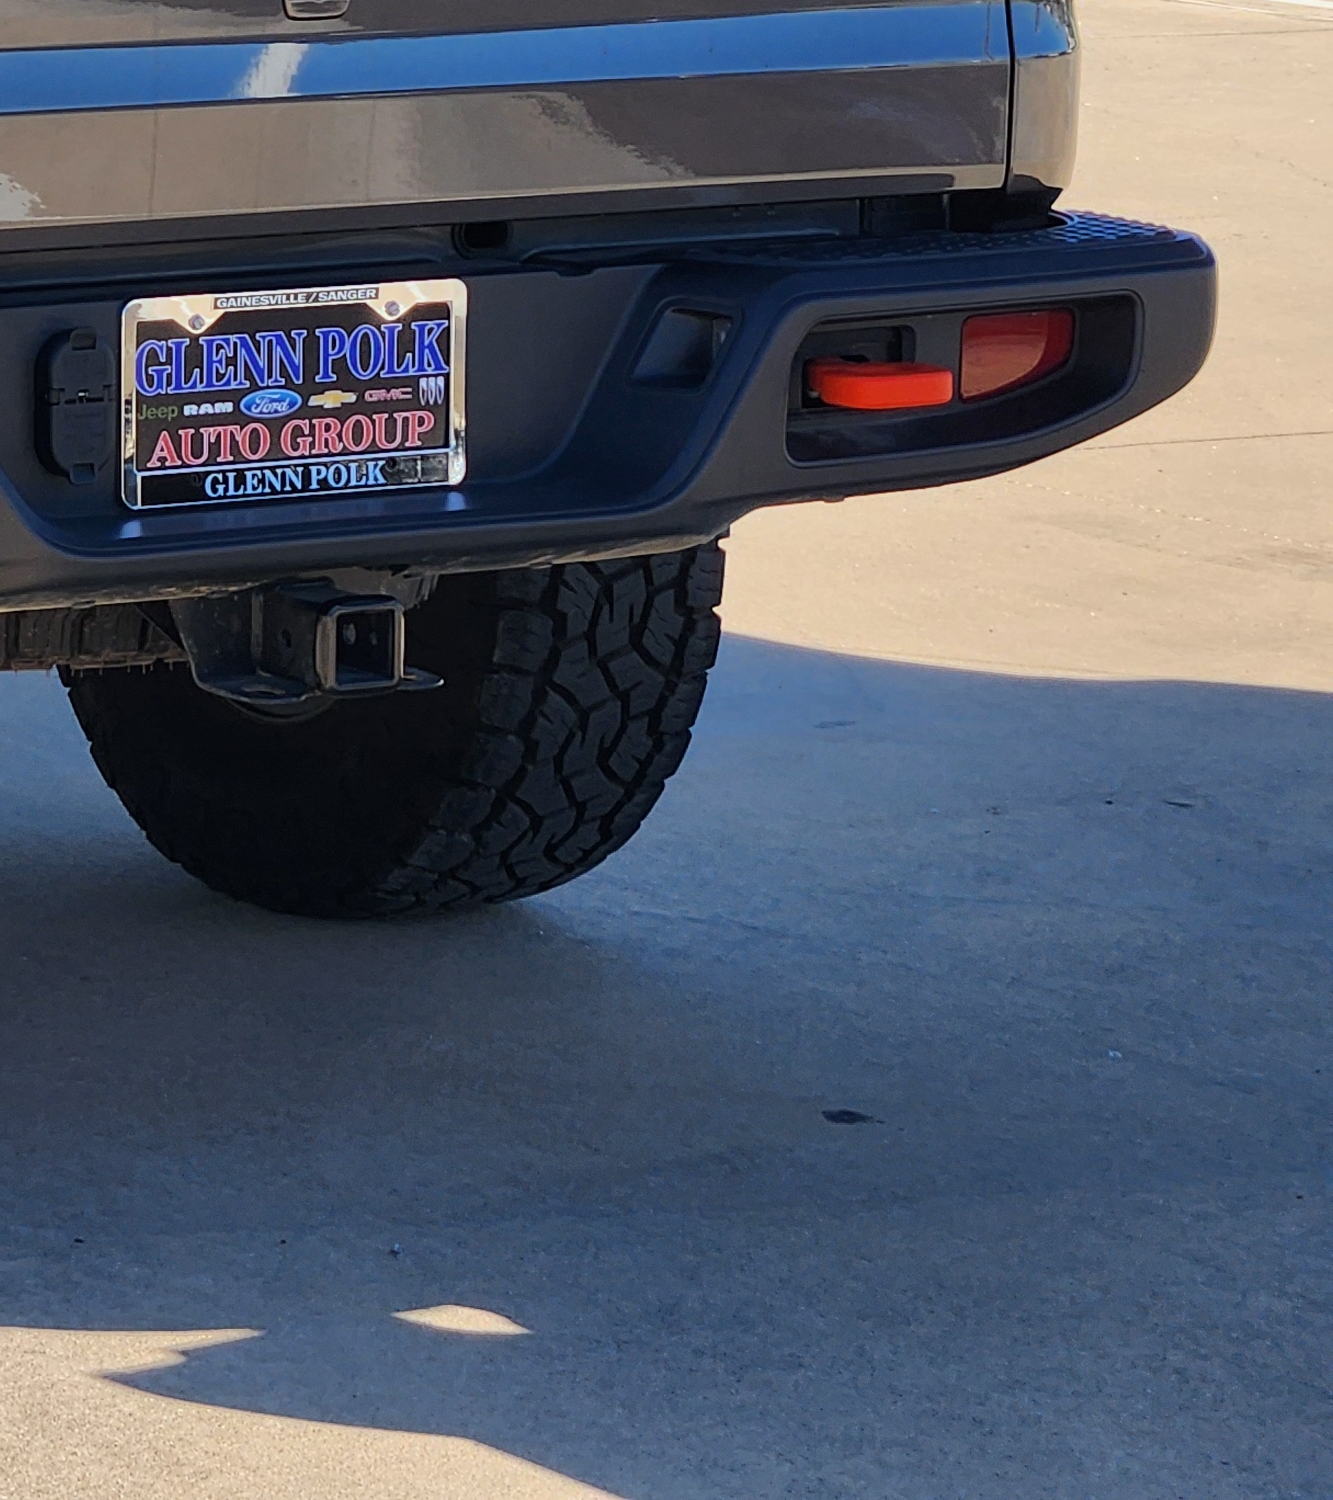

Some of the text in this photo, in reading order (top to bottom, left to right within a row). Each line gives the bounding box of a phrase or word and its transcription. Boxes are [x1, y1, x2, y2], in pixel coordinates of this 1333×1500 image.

[135, 319, 450, 396] GLENN POLK
[137, 387, 413, 421] Jeep RAM Ford GMC
[146, 410, 435, 468] AUTO GROUP
[204, 459, 388, 498] GLENN POLK
